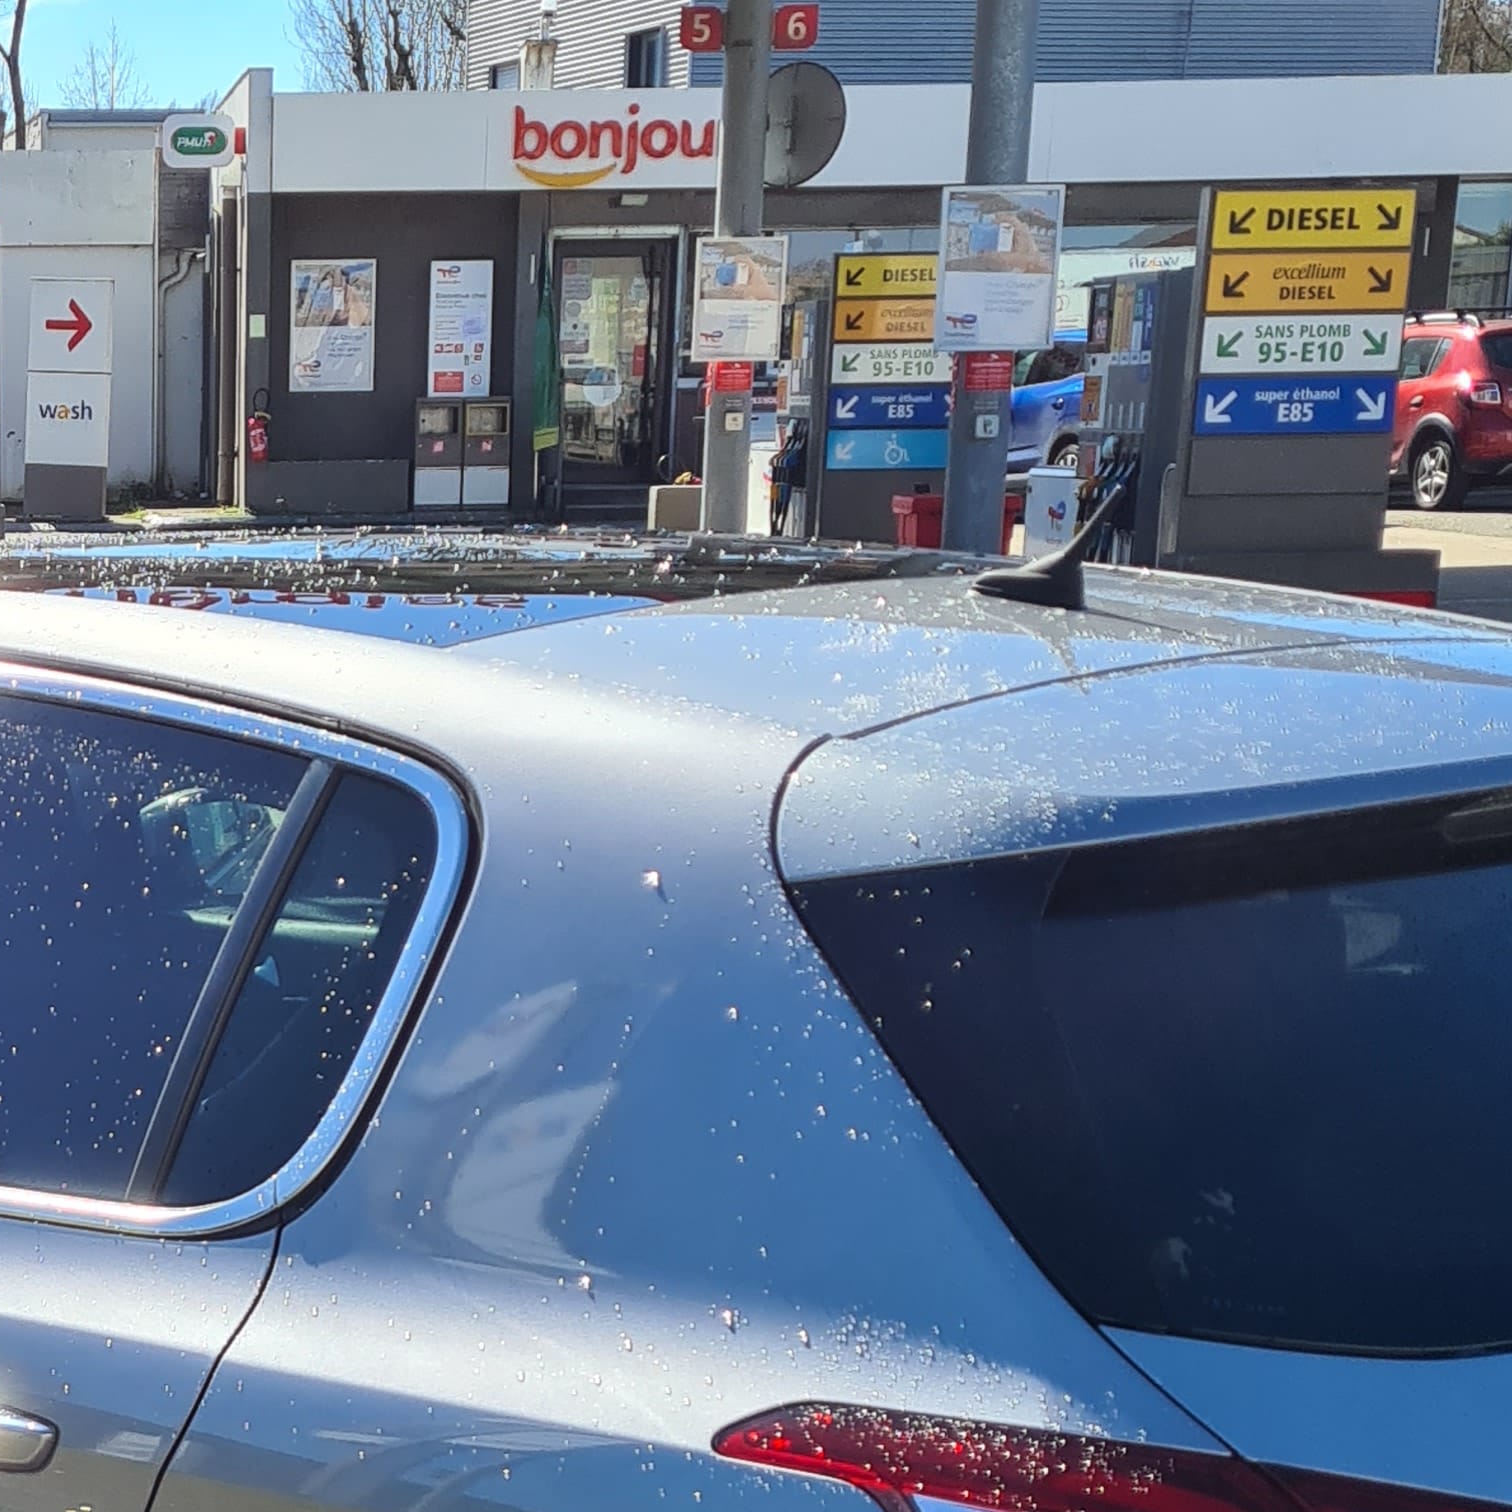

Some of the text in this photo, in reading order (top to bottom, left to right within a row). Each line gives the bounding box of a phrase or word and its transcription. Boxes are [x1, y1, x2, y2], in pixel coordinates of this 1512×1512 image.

[691, 13, 711, 43] 5
[787, 11, 807, 41] 6
[1266, 207, 1361, 231] DIESEL
[882, 268, 936, 282] DIESEL
[1272, 263, 1346, 280] excellium
[1279, 285, 1336, 300] DIESEL
[885, 321, 926, 333] DIESEL
[1254, 323, 1352, 339] SANS PLOMB
[869, 349, 898, 360] SANS
[1258, 341, 1345, 364] 95-E10
[872, 360, 934, 377] 95-E10
[1254, 386, 1341, 403] super éthanol
[38, 399, 93, 421] wash
[887, 404, 915, 419] E85
[1277, 402, 1314, 423] E85
